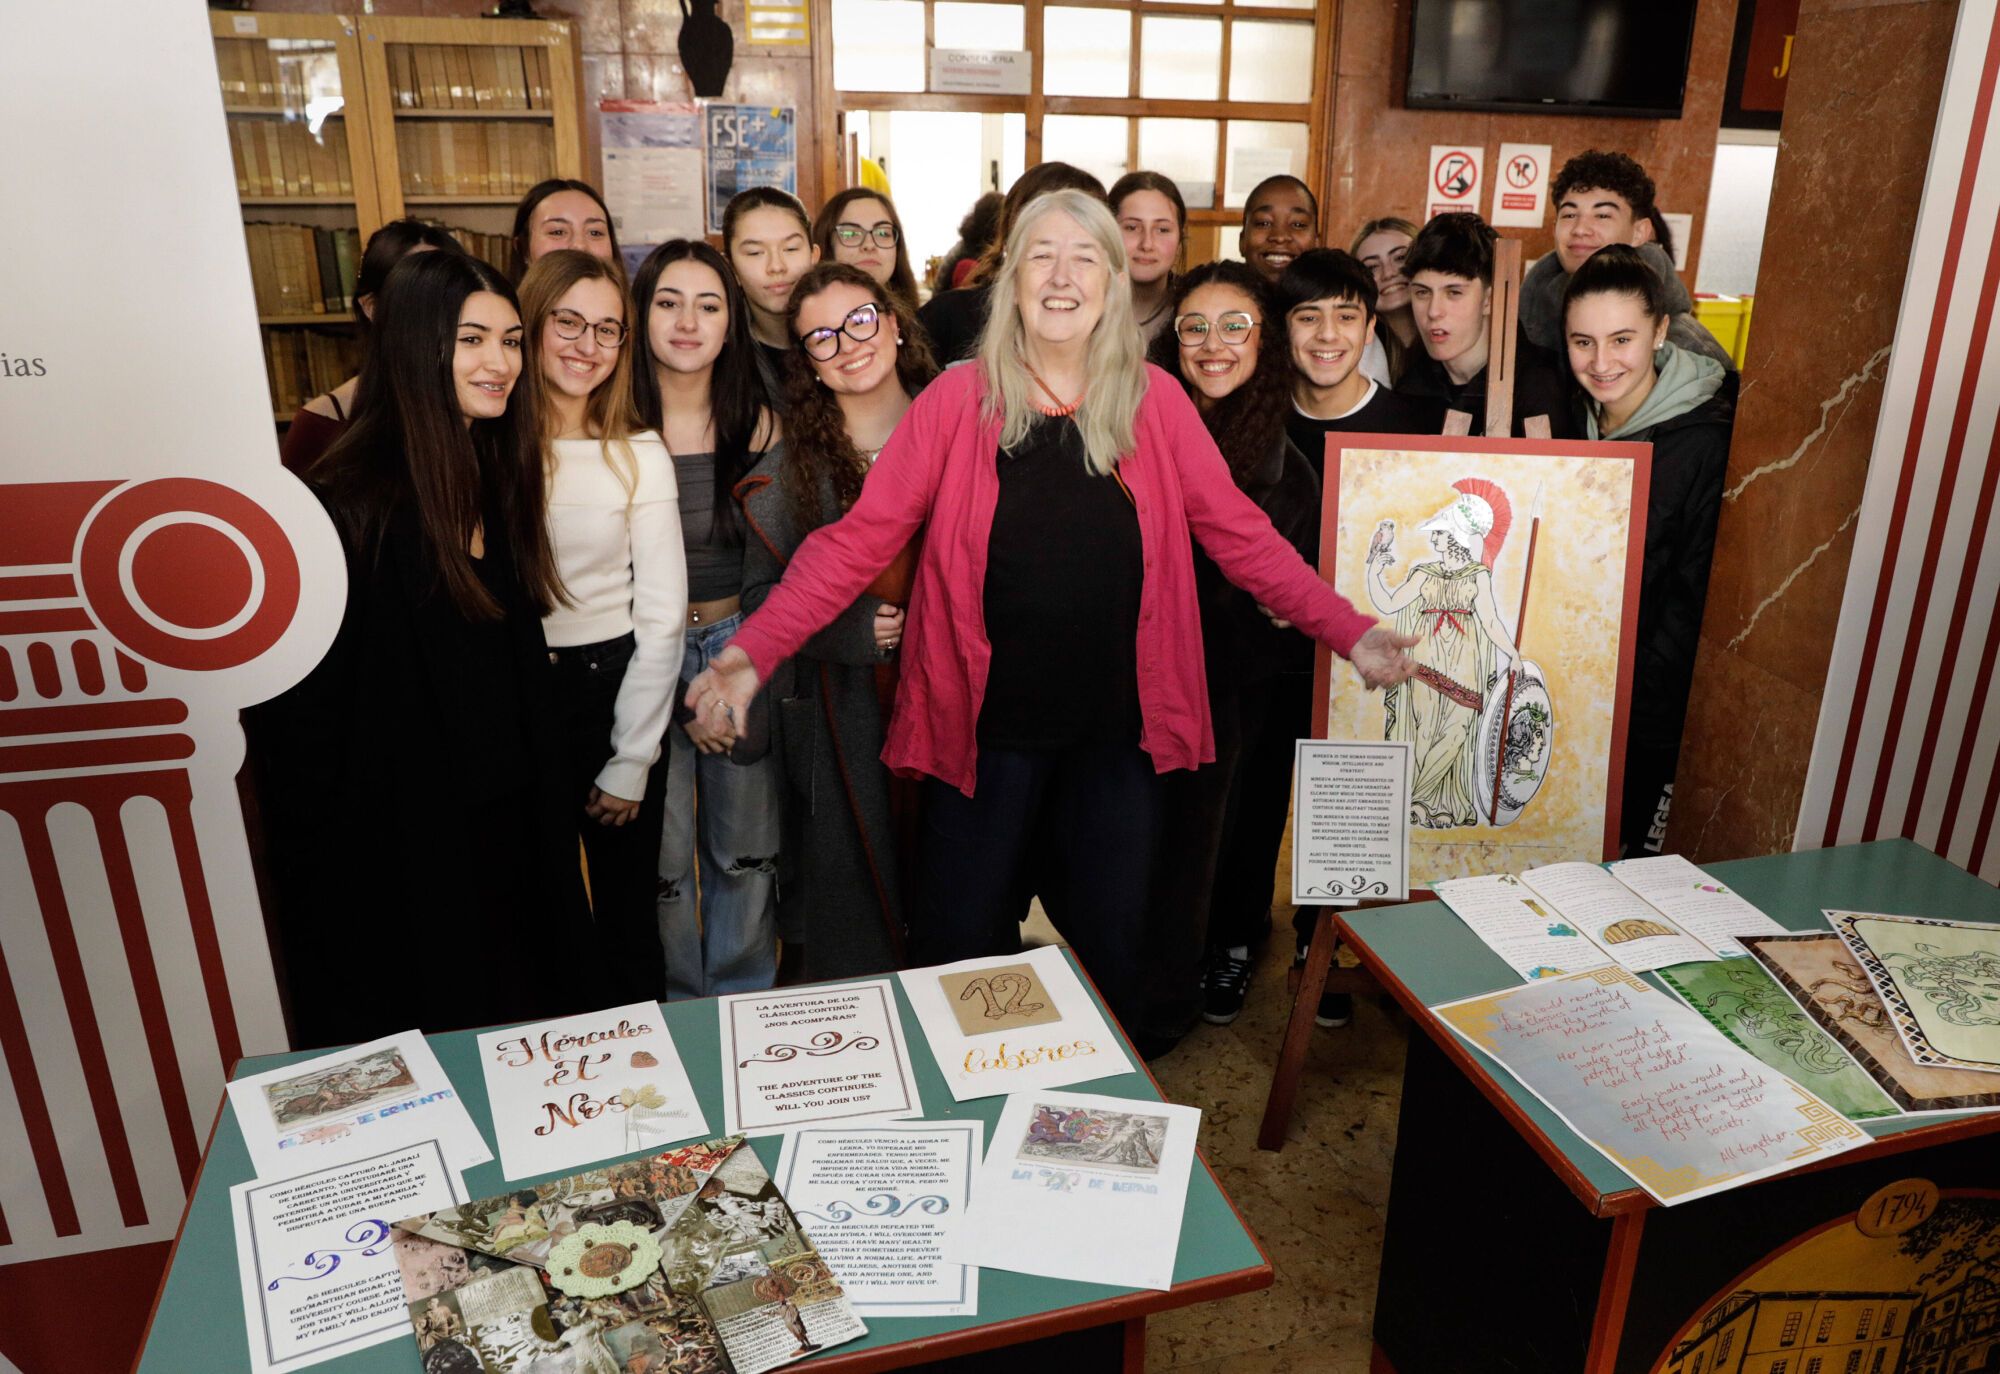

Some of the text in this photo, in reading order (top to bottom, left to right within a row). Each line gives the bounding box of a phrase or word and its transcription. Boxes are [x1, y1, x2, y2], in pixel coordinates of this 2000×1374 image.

[0, 352, 47, 377] ias
[772, 1000, 825, 1010] AVENTURA
[960, 973, 1045, 1019] 12
[759, 1010, 806, 1019] CLÁSICOS
[790, 1014, 856, 1026] ACOMPAÑAS?
[757, 1084, 778, 1092] THE
[781, 1076, 844, 1089] ADVENTURE
[764, 1089, 816, 1101] CLASSICS
[534, 1092, 627, 1136] Nos
[775, 1103, 801, 1111] WILL
[802, 1100, 824, 1108] YOU
[827, 1097, 850, 1105] JOIN
[1720, 1147, 1737, 1164] All
[351, 1168, 397, 1184] ESTUDIARÉ
[398, 1163, 415, 1171] UNA
[272, 1204, 318, 1220] OBTENDRÉ
[332, 1194, 354, 1204] BUEN
[356, 1183, 396, 1198] TRABAJO
[396, 1178, 413, 1186] QUE
[286, 1192, 338, 1209] CARRETERA
[340, 1174, 403, 1194] UNIVERSITARIA
[278, 1210, 324, 1227] PERMITIRÁ
[327, 1200, 362, 1213] AYUDAR
[383, 1184, 417, 1198] FAMILIA
[286, 1216, 334, 1232] DISFRUTAR
[349, 1207, 366, 1215] UNA
[368, 1198, 396, 1209] BUENA
[1876, 1190, 1928, 1228] 1794
[321, 1280, 367, 1296] HERCULES
[368, 1269, 401, 1282] CAPTU
[290, 1292, 356, 1315] ERYMANTHIAN
[290, 1304, 343, 1324] UNIVERSITY
[346, 1293, 381, 1307] COURSE
[383, 1286, 402, 1296] AND
[298, 1321, 316, 1331] JOB
[318, 1313, 342, 1324] THAT
[345, 1306, 367, 1316] WILL
[369, 1295, 400, 1309] ALLOW
[296, 1332, 309, 1340] MY
[312, 1320, 347, 1336] FAMILY
[350, 1314, 369, 1324] AND
[370, 1304, 399, 1318] ENJOY
